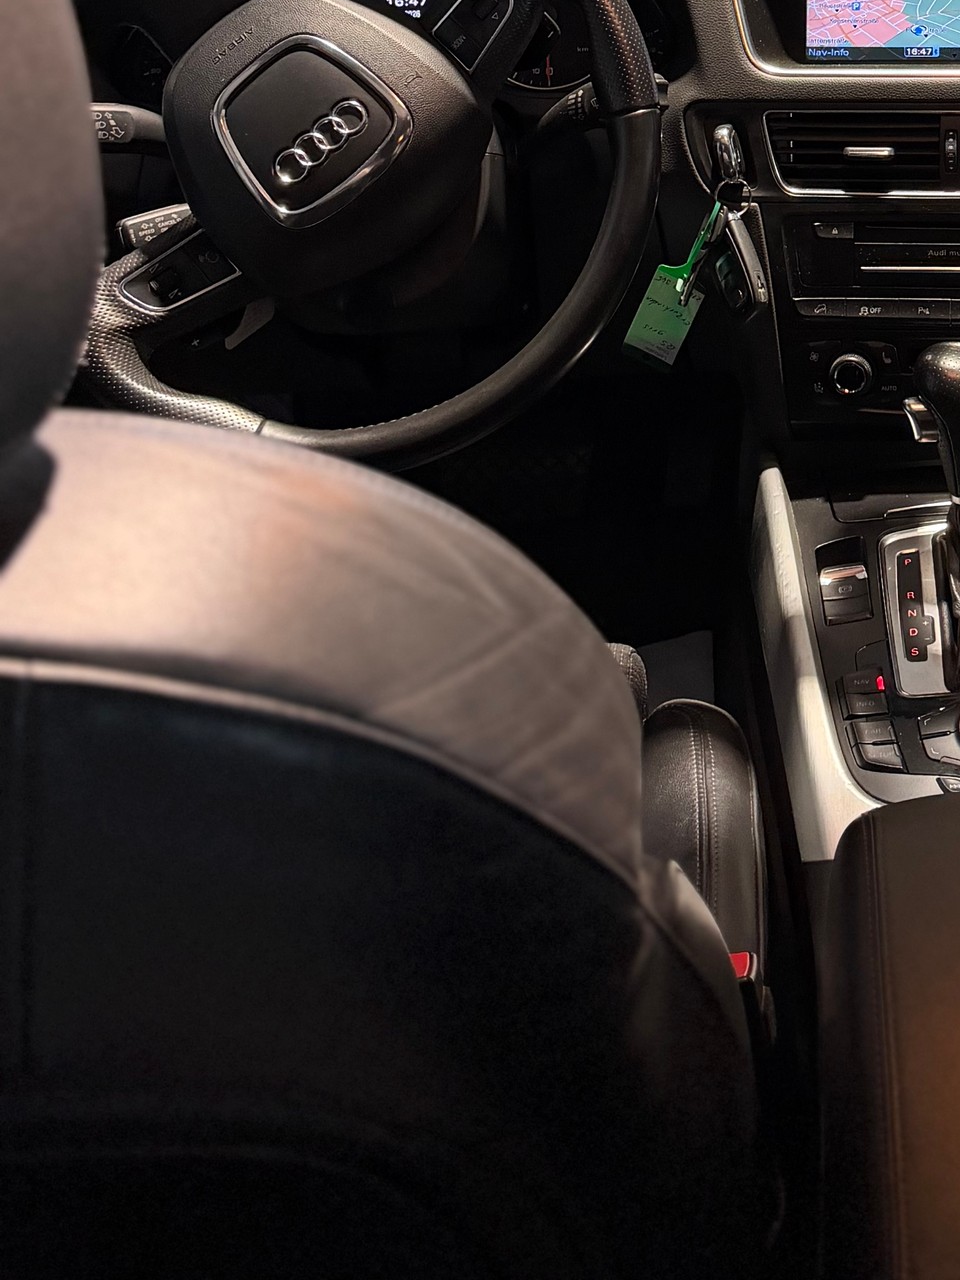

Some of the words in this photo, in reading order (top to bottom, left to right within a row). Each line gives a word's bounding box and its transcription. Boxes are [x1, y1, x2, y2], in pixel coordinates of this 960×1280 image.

[808, 48, 850, 58] Nav-Info
[905, 48, 932, 56] 16:47
[904, 558, 912, 566] P
[907, 591, 915, 600] R
[907, 609, 917, 617] N
[909, 627, 919, 637] D
[911, 647, 919, 656] S
